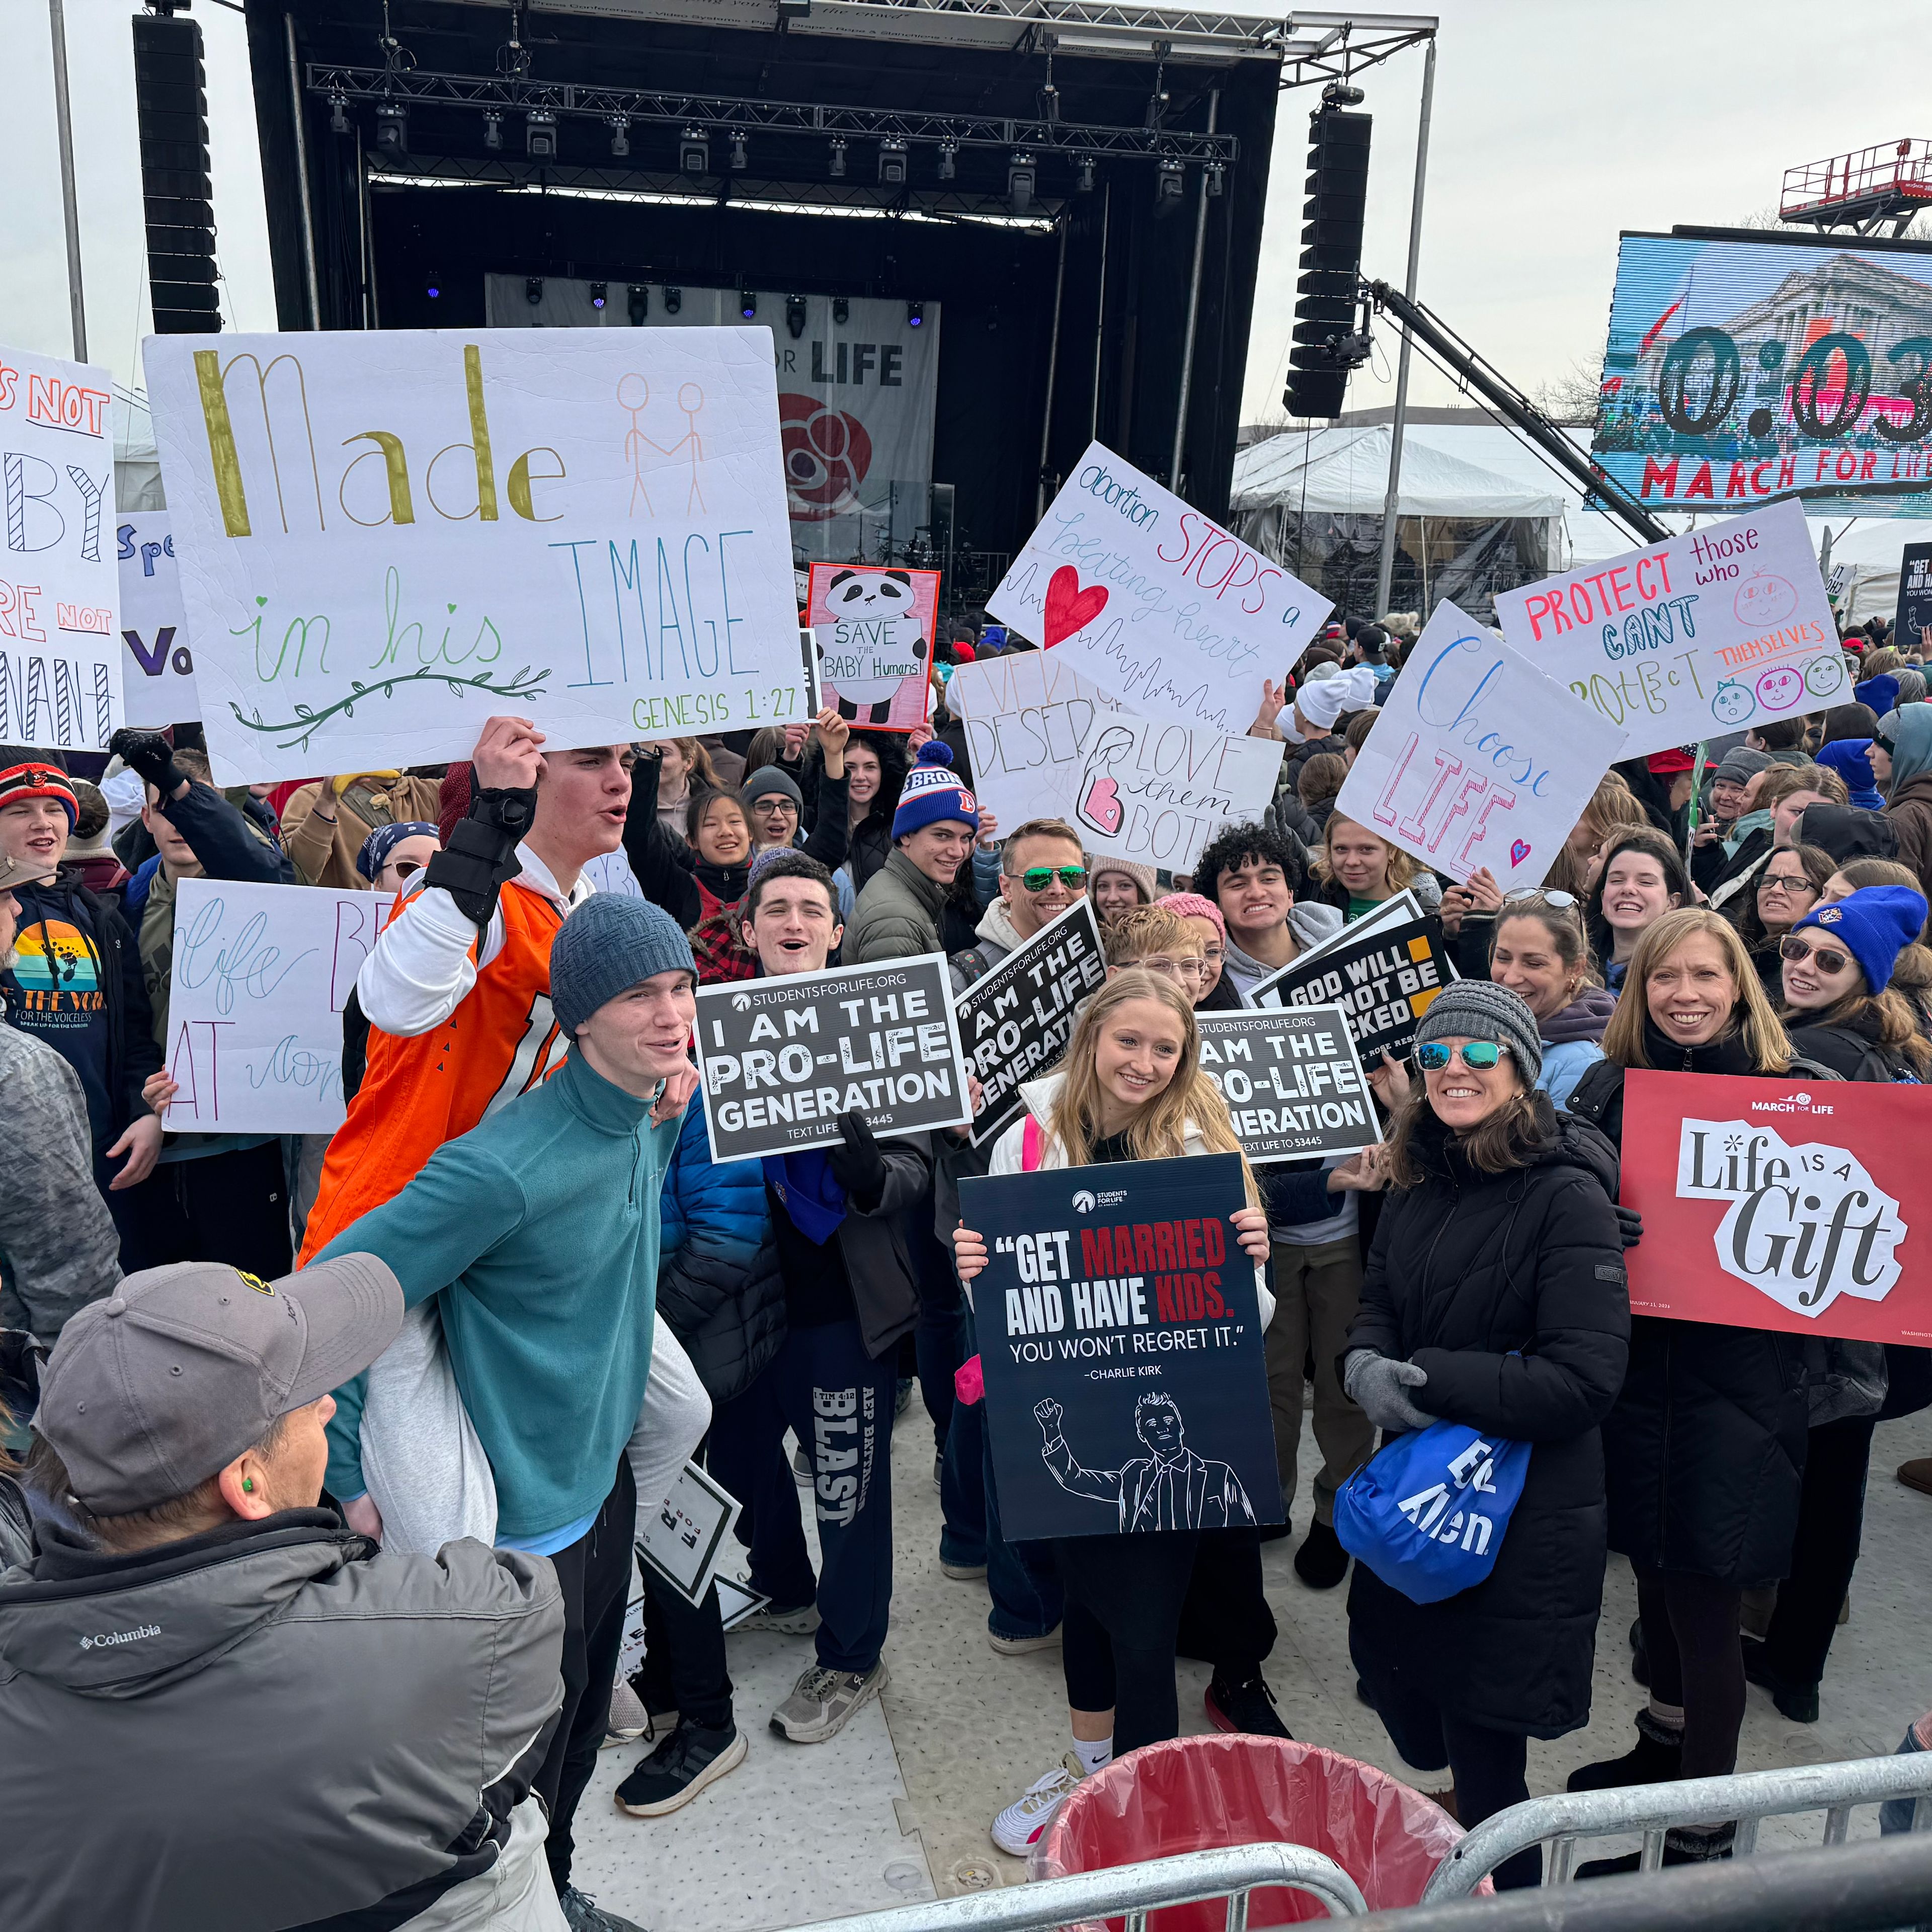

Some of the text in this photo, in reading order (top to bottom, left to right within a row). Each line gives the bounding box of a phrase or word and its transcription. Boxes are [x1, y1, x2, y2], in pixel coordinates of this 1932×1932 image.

[570, 4, 644, 15] Conferences
[692, 15, 741, 23] Systems
[811, 341, 903, 386] LIFE
[0, 364, 110, 434] S NOT
[193, 344, 567, 537] Made
[1639, 454, 1798, 499] MARCH
[1815, 449, 1878, 483] FOR
[4, 453, 110, 562] BY
[1079, 465, 1301, 628] abortion STOPS a
[1523, 527, 1759, 641] PROTECT those
[1695, 563, 1740, 587] who
[1906, 574, 1923, 589] AND
[57, 603, 112, 630] NOT
[229, 530, 759, 687] in his IMAGE
[1602, 595, 1700, 661] CANT
[835, 621, 898, 646] SAVE
[856, 646, 874, 654] THE
[1173, 602, 1260, 678] heart
[1714, 620, 1825, 667] THEMSELVES
[824, 655, 864, 678] BABY
[0, 651, 115, 749] NANT
[632, 687, 796, 731] GENESIS 1:27
[1417, 629, 1550, 797] Choose
[912, 771, 963, 789] BRON
[1135, 722, 1247, 794] LOVE
[1123, 775, 1258, 815] them
[1373, 731, 1516, 879] LIFE
[1125, 804, 1212, 865] BOT
[971, 925, 1068, 1008] STUDENTSFORLIFE.ORG
[975, 930, 1086, 1040] AM THE
[1290, 945, 1410, 1006] GOD WILL
[1334, 960, 1440, 1017] NOT BE
[23, 990, 63, 1011] THE
[753, 973, 907, 1007] STUDENTSFORLIFE.ORG
[15, 1009, 93, 1023] FOR THE VOICELESS
[712, 989, 930, 1048] I AM THE
[1197, 1016, 1316, 1034] STUDENTSFORLIFE.ORG
[1348, 1000, 1414, 1043] CKED
[167, 1020, 236, 1121] AT
[705, 1021, 952, 1096] PRO-LIFE
[1199, 1031, 1338, 1065] AM THE
[1369, 1041, 1392, 1057] ROSE
[717, 1067, 952, 1132] GENERATION
[1203, 1060, 1361, 1105] O-LIFE
[786, 1113, 894, 1140] TEXT LIFE 3445
[1231, 1099, 1366, 1137] NERATION
[1751, 1101, 1795, 1113] MARCH
[1812, 1104, 1834, 1115] LIFE
[1240, 1136, 1322, 1153] TEXT LIFE TO 53445
[1687, 1131, 1852, 1193] Life IS A
[1097, 1190, 1128, 1198] STUDENTS
[1080, 1217, 1227, 1278] MARRIED
[1732, 1184, 1891, 1307] Gift
[1005, 1271, 1234, 1336] AND HAVE KIDS.
[1009, 1342, 1053, 1364] YOU
[1058, 1334, 1126, 1360] WON’T
[1133, 1328, 1208, 1353] REGRET
[1901, 1330, 1932, 1338] WASHINGT
[1138, 1364, 1163, 1377] KIRK
[813, 1387, 858, 1528] BLAST
[94, 1623, 162, 1647] Columbia
